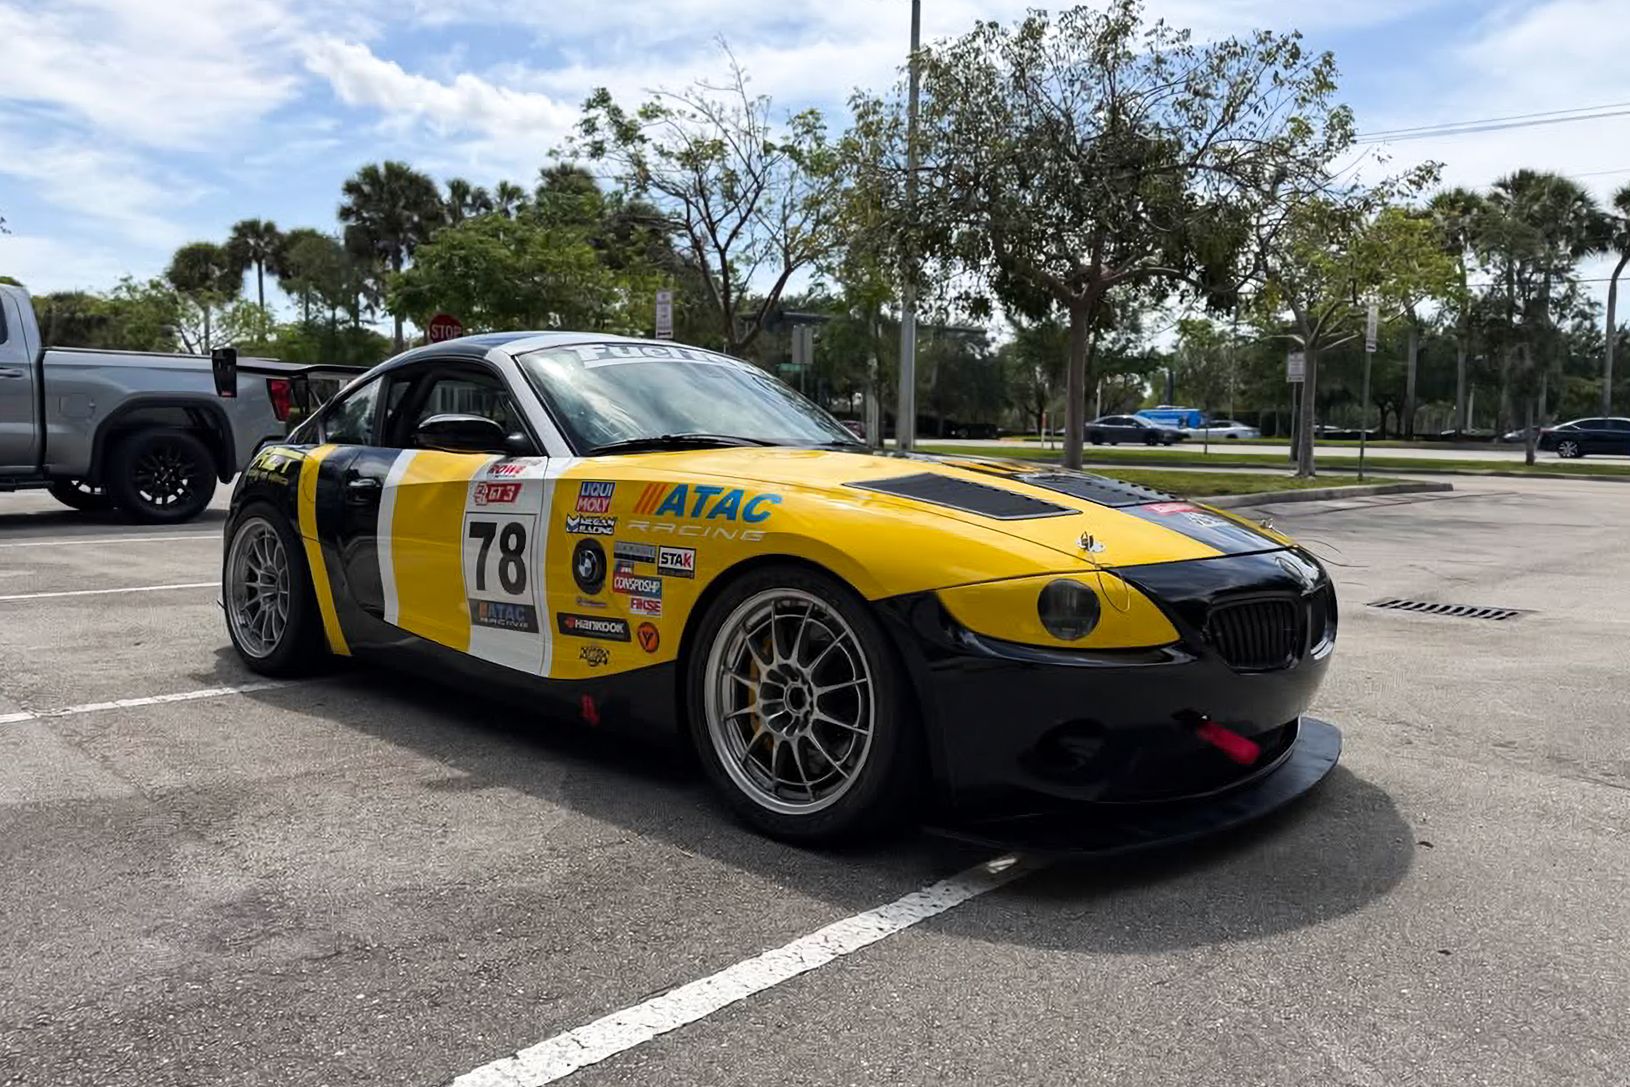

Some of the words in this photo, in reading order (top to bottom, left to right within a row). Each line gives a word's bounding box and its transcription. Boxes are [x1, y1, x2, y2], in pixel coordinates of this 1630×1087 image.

[431, 324, 462, 339] STOP
[581, 483, 614, 496] LIQUI
[577, 497, 609, 511] MOLY
[655, 483, 783, 523] ATAC
[627, 520, 767, 541] RACING
[469, 521, 527, 595] 78
[660, 552, 693, 569] STAK
